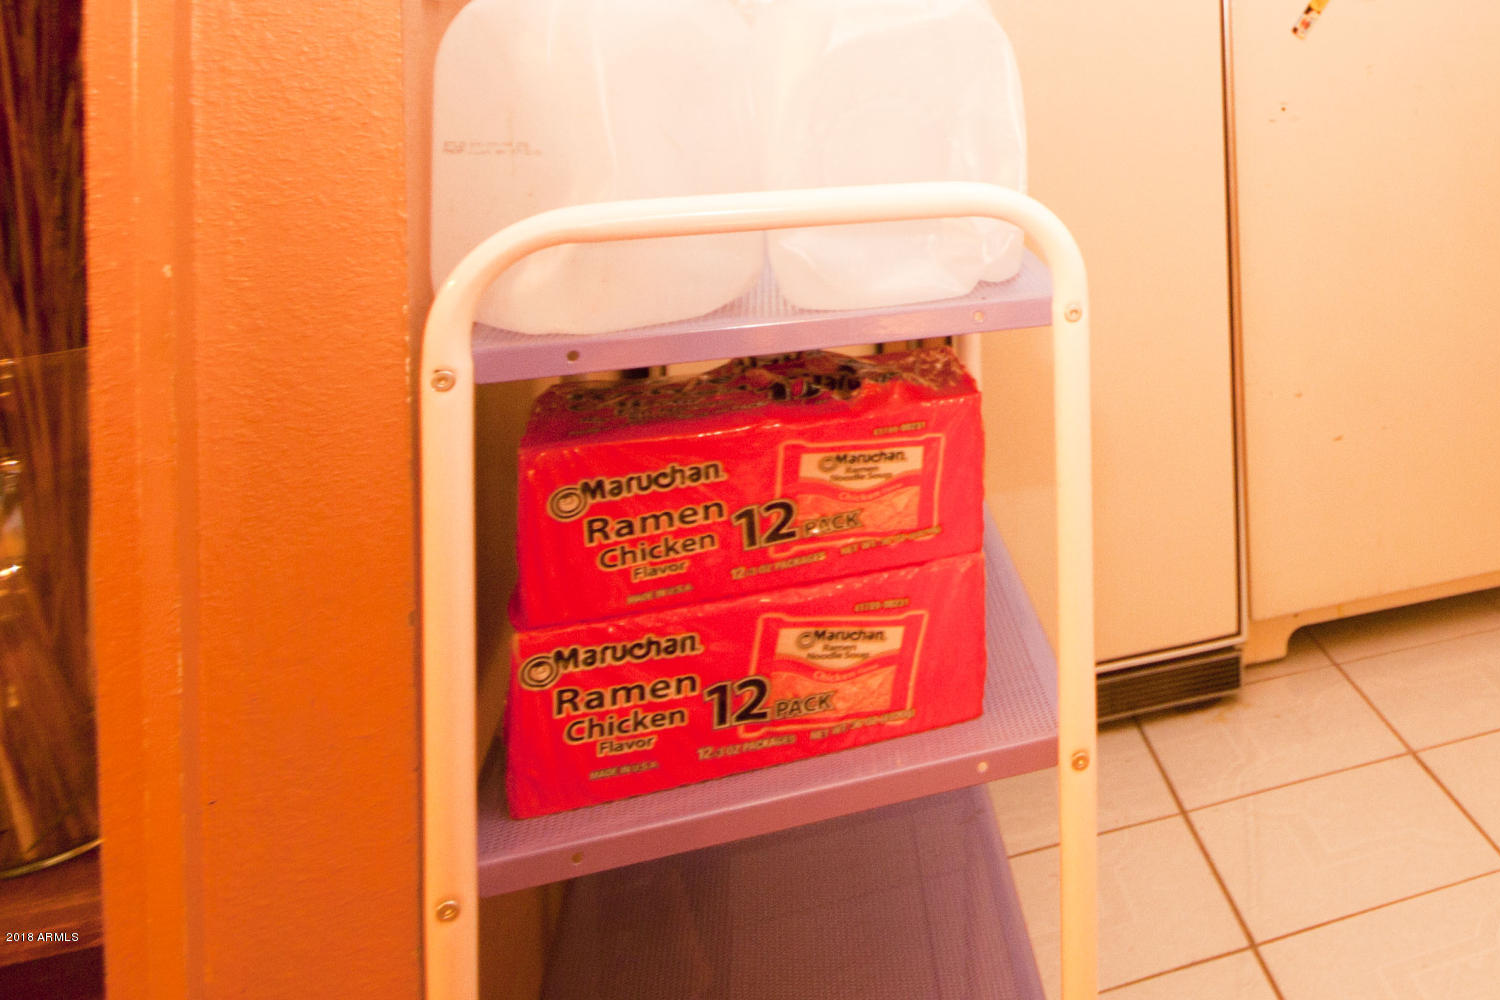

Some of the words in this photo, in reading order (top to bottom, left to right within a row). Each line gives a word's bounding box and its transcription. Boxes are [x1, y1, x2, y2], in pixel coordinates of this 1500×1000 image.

[835, 450, 907, 465] Maruchan
[579, 462, 724, 501] Maruchan
[584, 500, 727, 546] Ramen
[731, 498, 799, 551] 12
[801, 507, 864, 537] PACK
[598, 532, 718, 571] Chicken
[632, 560, 690, 583] Flavor
[552, 632, 703, 671] Maruchan
[813, 628, 886, 642] Maruchan
[553, 673, 700, 718] Ramen
[703, 675, 771, 731] 12
[774, 691, 837, 721] PACK
[565, 707, 689, 745] Chicken
[596, 735, 657, 758] Flavor
